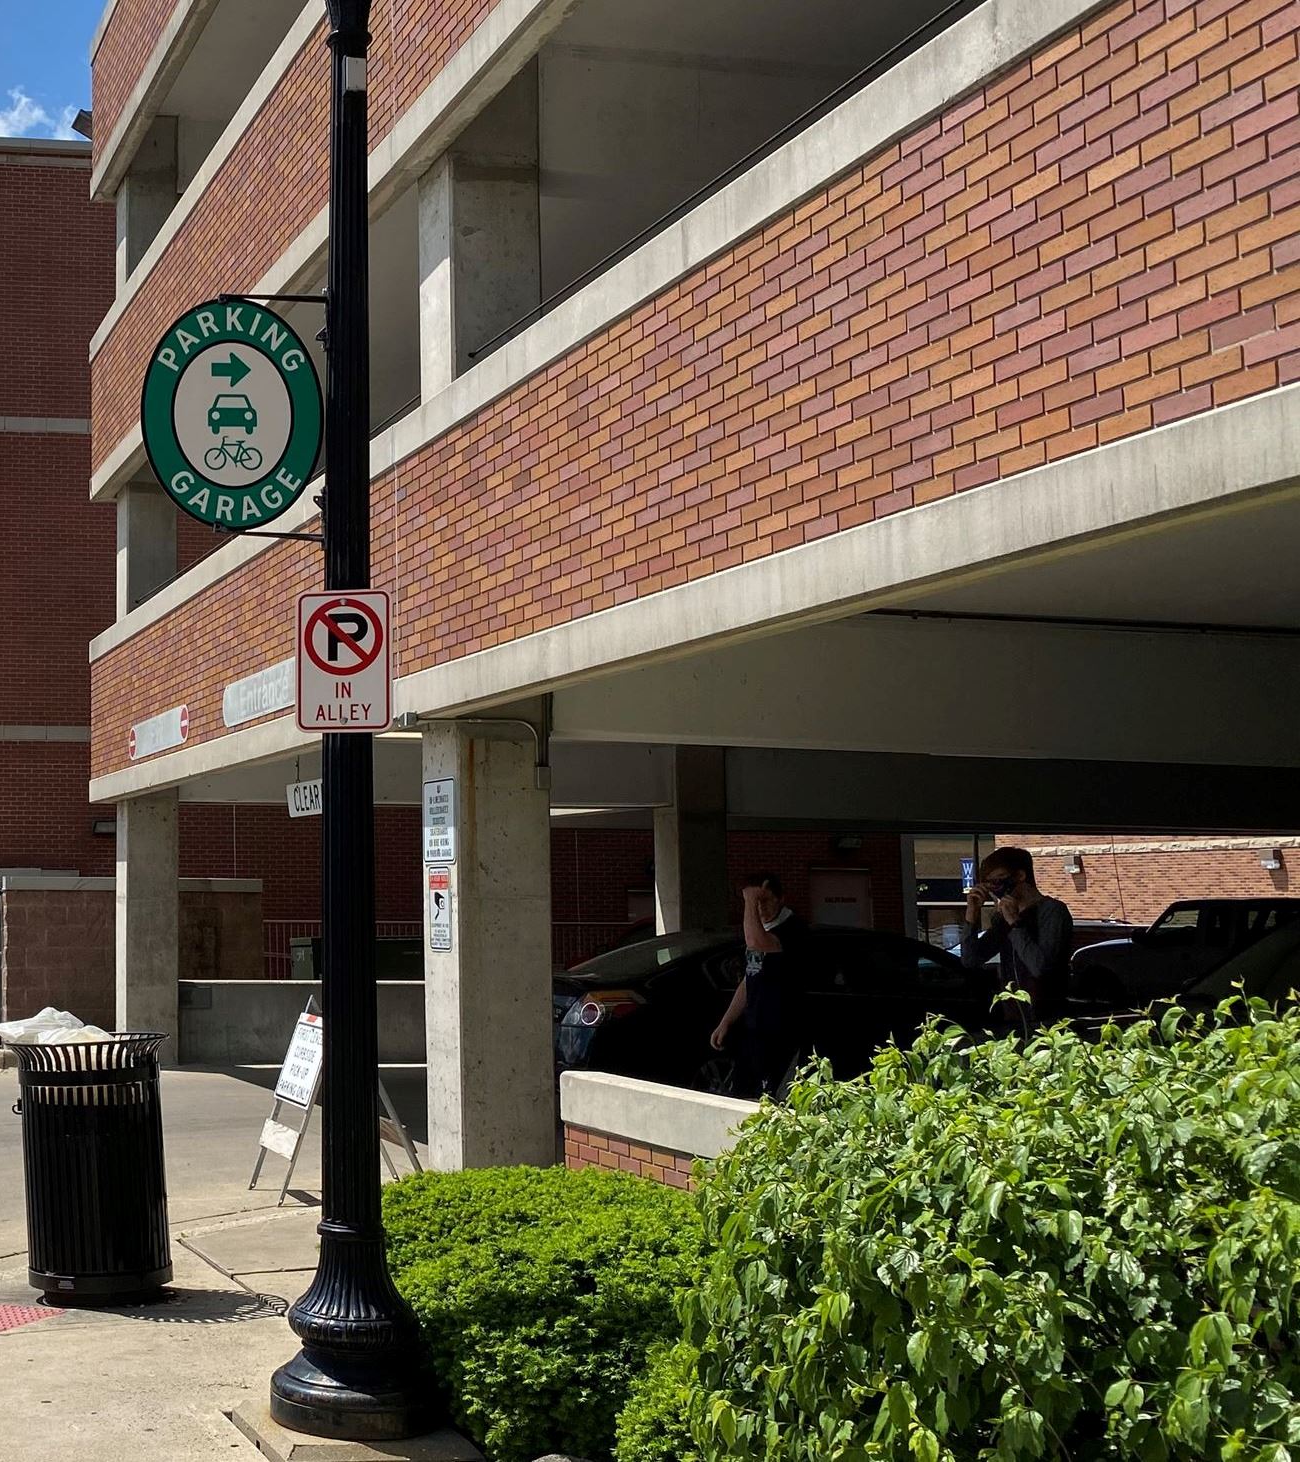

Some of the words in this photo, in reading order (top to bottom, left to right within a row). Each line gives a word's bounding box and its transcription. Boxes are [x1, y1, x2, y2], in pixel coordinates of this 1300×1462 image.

[157, 307, 305, 372] PARKING
[170, 467, 302, 521] GARAGE
[239, 676, 288, 714] Entrance
[336, 682, 351, 698] IN
[316, 704, 372, 721] ALLEY
[294, 784, 323, 812] CLEAR
